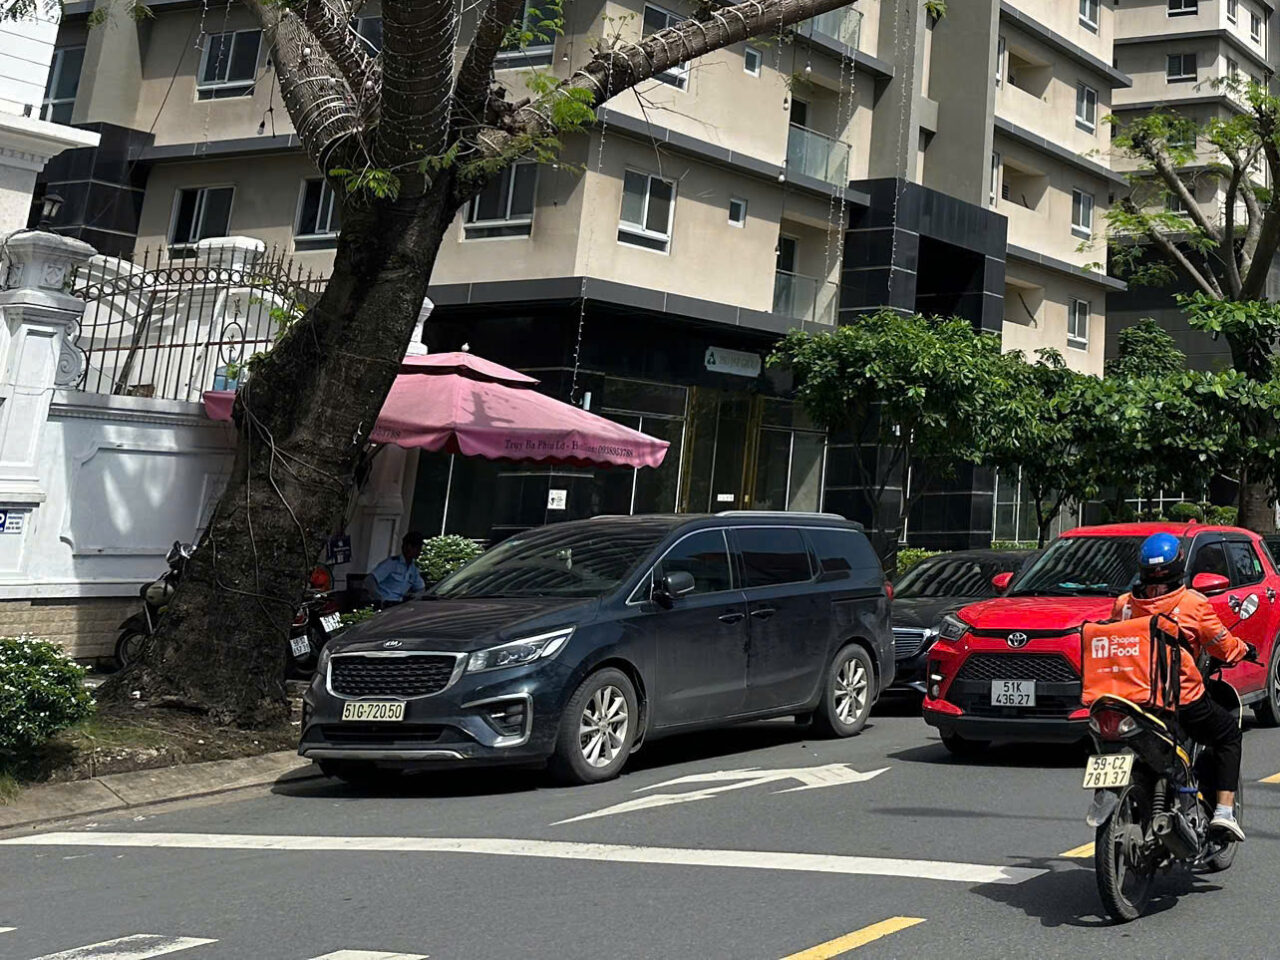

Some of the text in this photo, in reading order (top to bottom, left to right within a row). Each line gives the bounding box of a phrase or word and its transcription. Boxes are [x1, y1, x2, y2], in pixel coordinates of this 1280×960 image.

[1110, 635, 1140, 645] Shopee
[1110, 644, 1140, 657] Food
[1003, 682, 1023, 693] 51K
[995, 693, 1031, 705] 436.27
[344, 703, 403, 719] 51G-720.50
[1093, 756, 1127, 771] 59-C2
